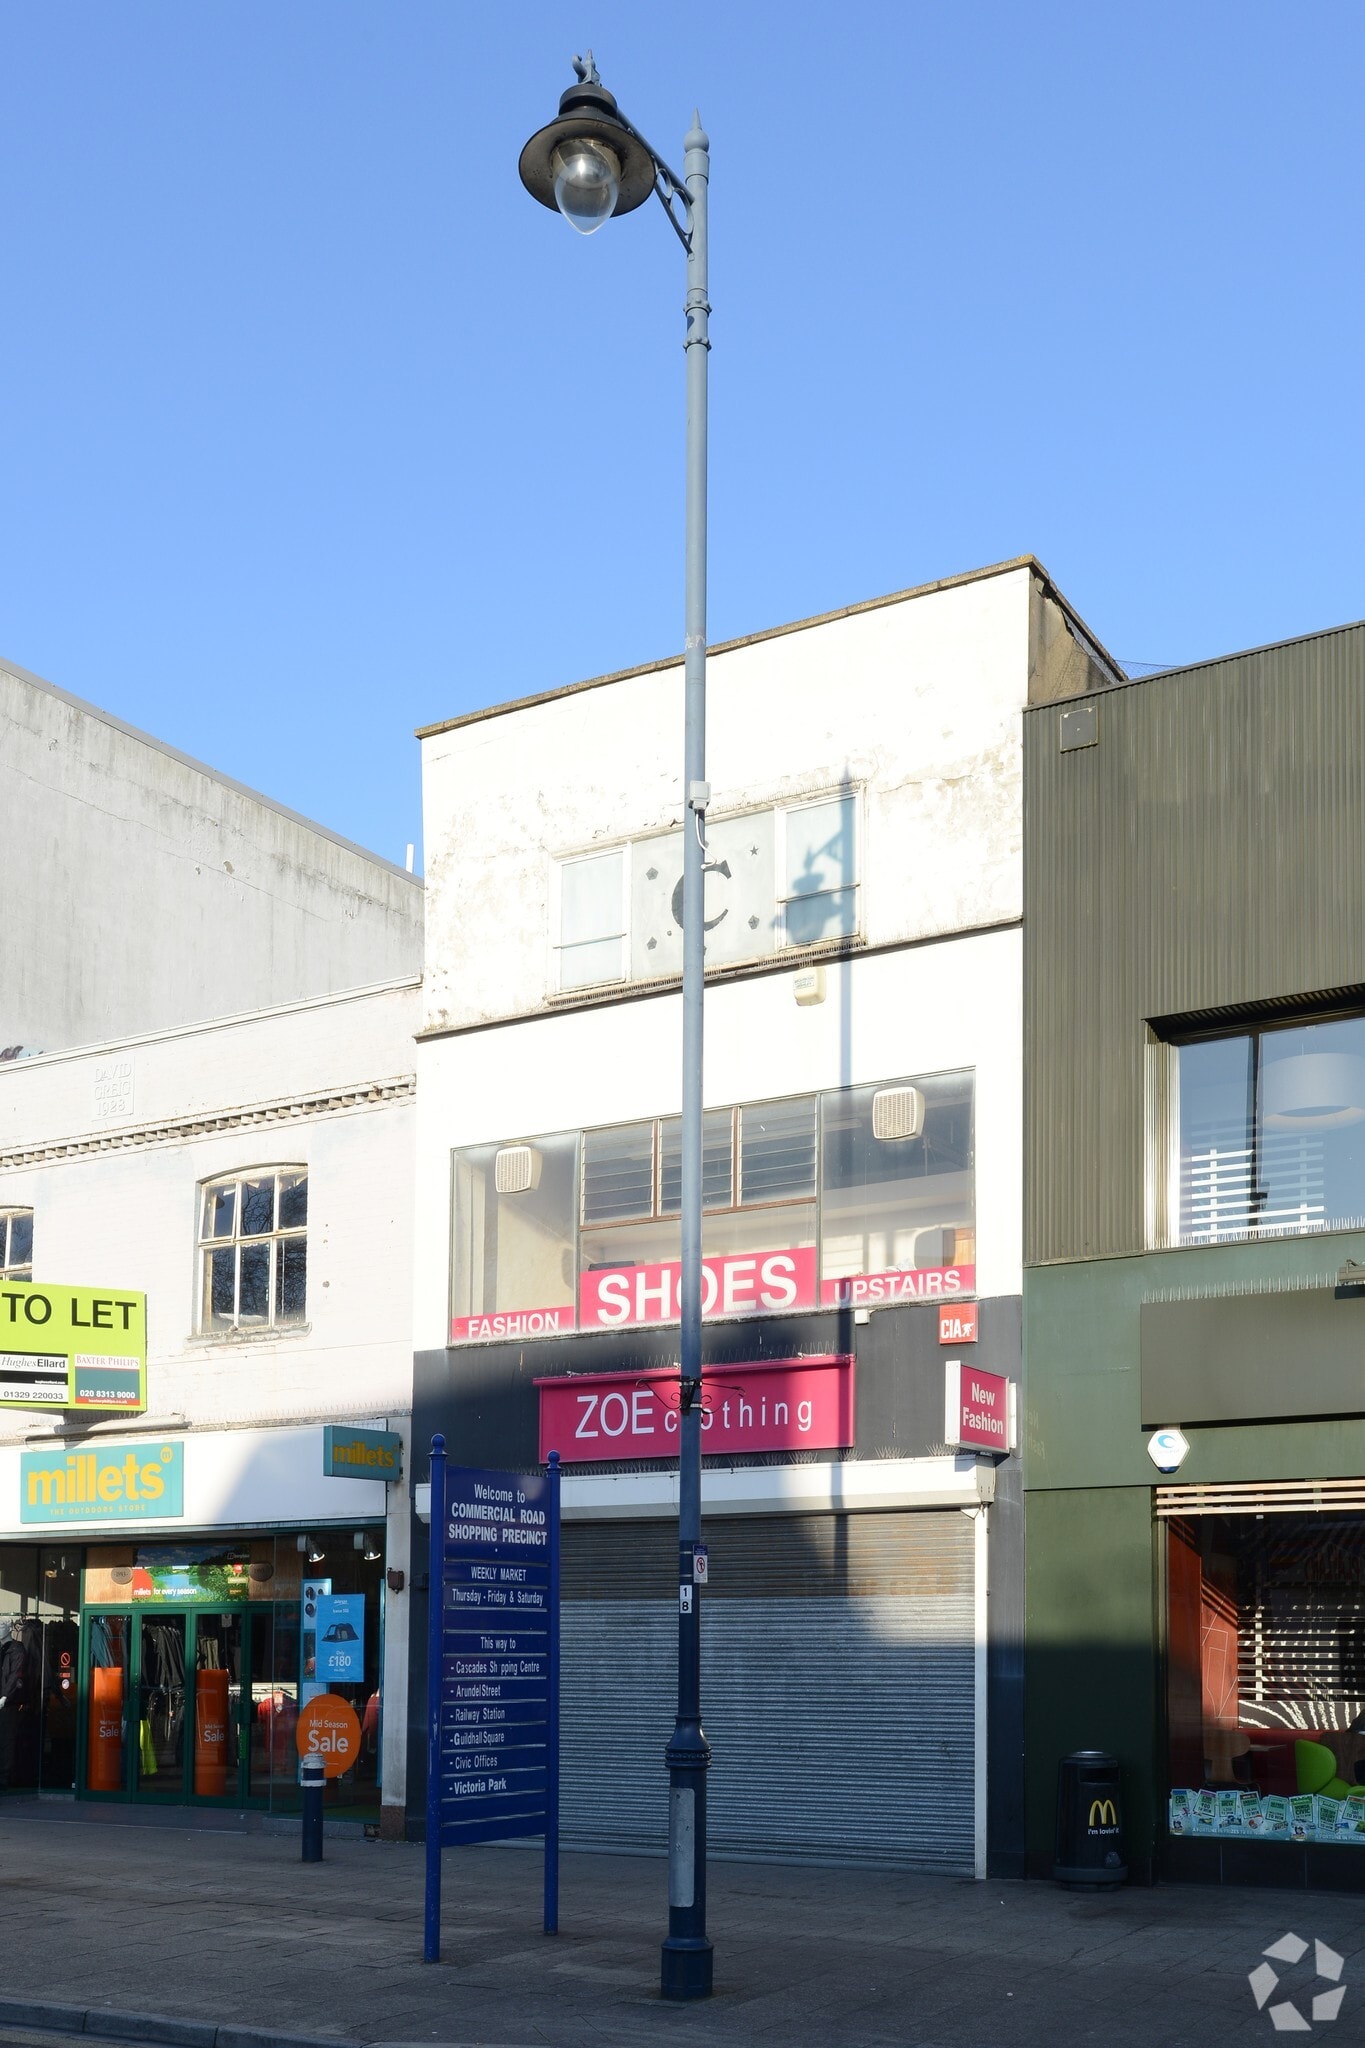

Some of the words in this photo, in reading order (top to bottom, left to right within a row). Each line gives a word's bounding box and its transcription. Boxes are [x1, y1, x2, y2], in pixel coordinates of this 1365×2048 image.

[834, 1270, 961, 1303] UPSTAIRS
[2, 1293, 51, 1325] TO
[71, 1298, 136, 1330] LET
[468, 1312, 559, 1339] FASHION
[941, 1319, 961, 1339] CIA
[76, 1355, 105, 1366] BAXTER
[3, 1391, 30, 1399] 01329
[32, 1392, 64, 1400] 220033
[79, 1390, 95, 1398] 020
[96, 1390, 115, 1398] 8313
[116, 1391, 136, 1399] 9000
[972, 1382, 996, 1406] New
[575, 1391, 654, 1439] ZOE
[664, 1396, 812, 1433] cothing
[963, 1407, 1003, 1434] Fashion
[333, 1441, 394, 1468] millets
[27, 1453, 165, 1505] millets
[474, 1484, 513, 1502] Welcome
[517, 1489, 526, 1503] to
[49, 1508, 65, 1516] THE
[451, 1502, 516, 1523] COMMERCIAL
[520, 1509, 546, 1525] ROAD
[448, 1524, 498, 1542] SHOPPING
[502, 1528, 548, 1546] PRECINCT
[471, 1566, 498, 1580] WEEKLY
[500, 1568, 527, 1582] MARKET
[162, 1589, 176, 1597] every
[452, 1588, 482, 1606] Thursday
[487, 1590, 507, 1606] Friday
[517, 1591, 544, 1607] Saturday
[480, 1636, 494, 1650] This
[494, 1639, 508, 1652] way
[509, 1637, 516, 1649] to
[328, 1655, 351, 1667] £180
[456, 1661, 487, 1674] Cascades
[489, 1661, 518, 1676] Shpping
[520, 1660, 540, 1673] Centre
[309, 1719, 323, 1728] Mid
[324, 1720, 348, 1729] Season
[455, 1709, 480, 1723] Railway
[482, 1707, 506, 1720] Station
[99, 1726, 119, 1738] Sale
[204, 1729, 225, 1742] Sale
[308, 1730, 349, 1753] Sale
[455, 1757, 472, 1769] Civic
[474, 1755, 498, 1768] Offices
[454, 1781, 486, 1795] Victoria
[488, 1777, 507, 1792] Park
